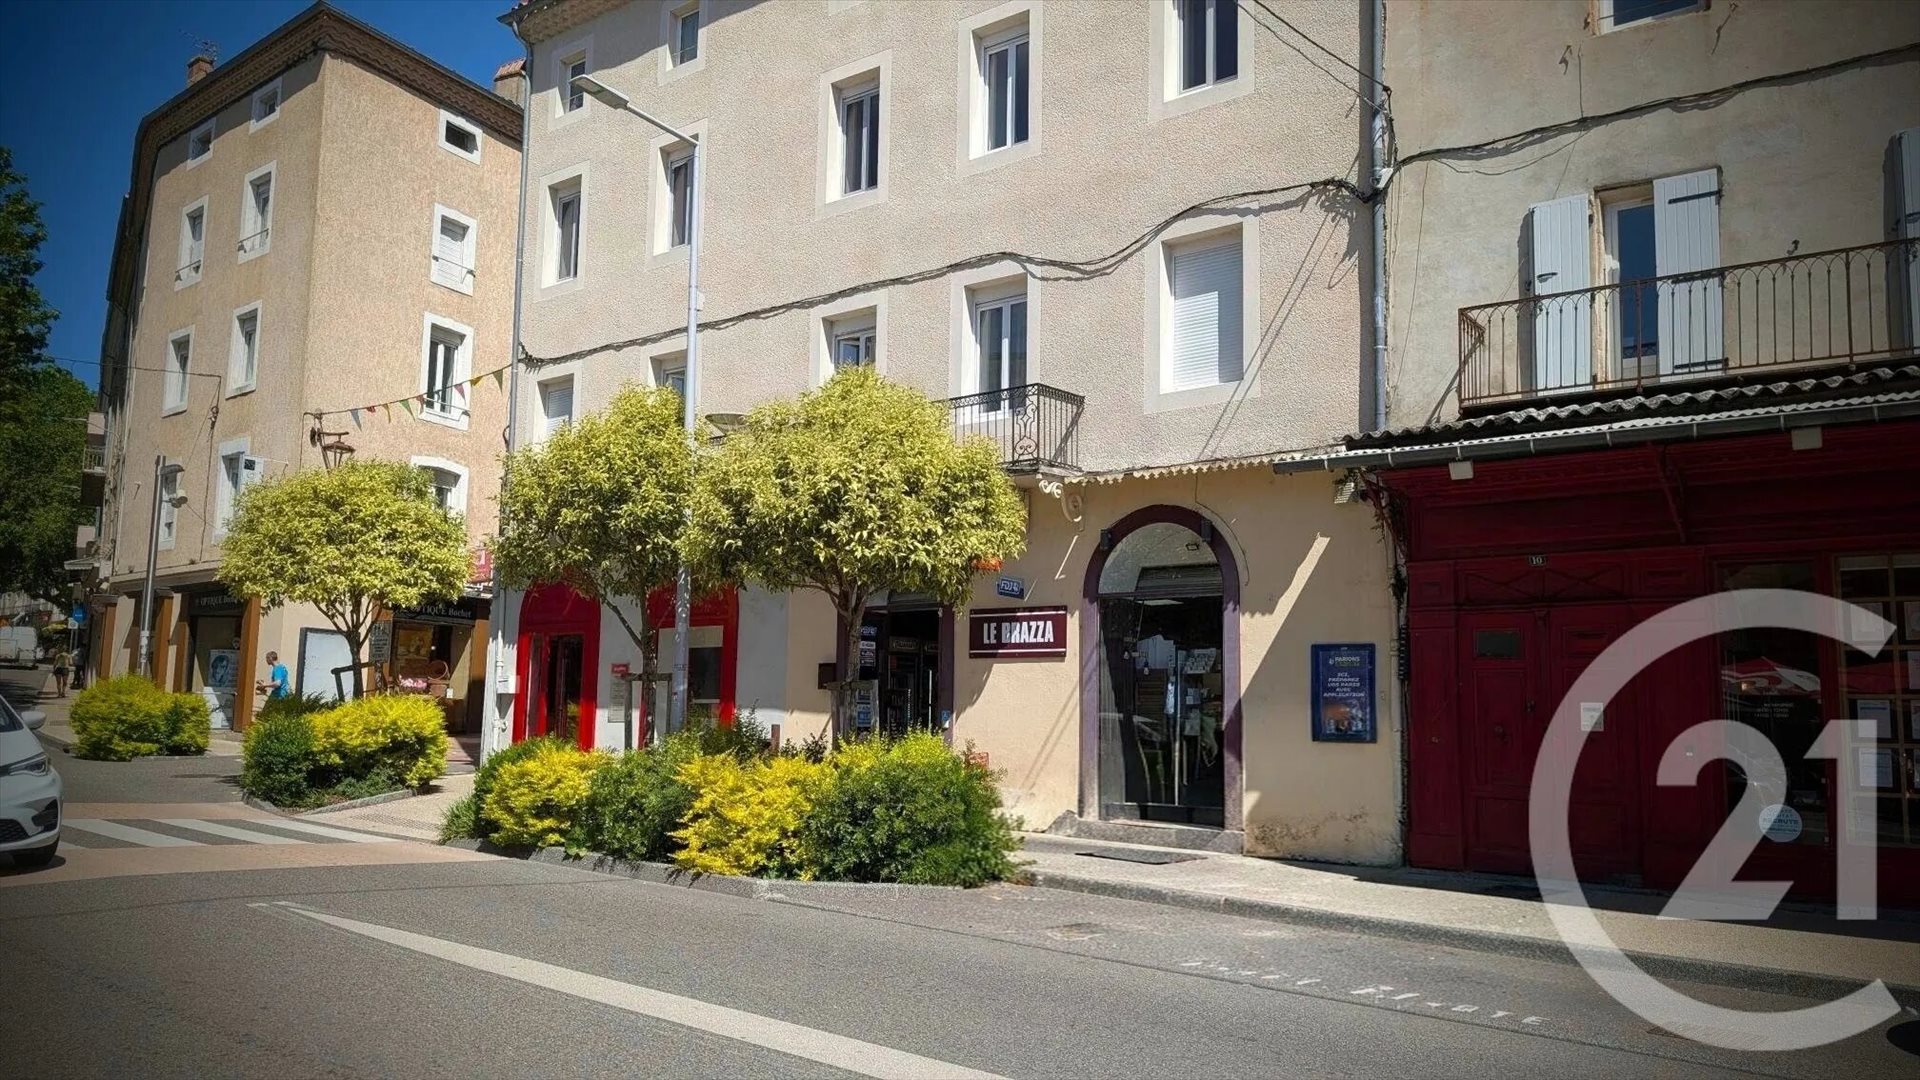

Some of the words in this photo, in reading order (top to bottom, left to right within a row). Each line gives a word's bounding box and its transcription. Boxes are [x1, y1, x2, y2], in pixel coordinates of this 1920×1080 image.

[1531, 556, 1543, 565] 10
[983, 622, 997, 644] LE
[1001, 620, 1055, 644] BRAZZA
